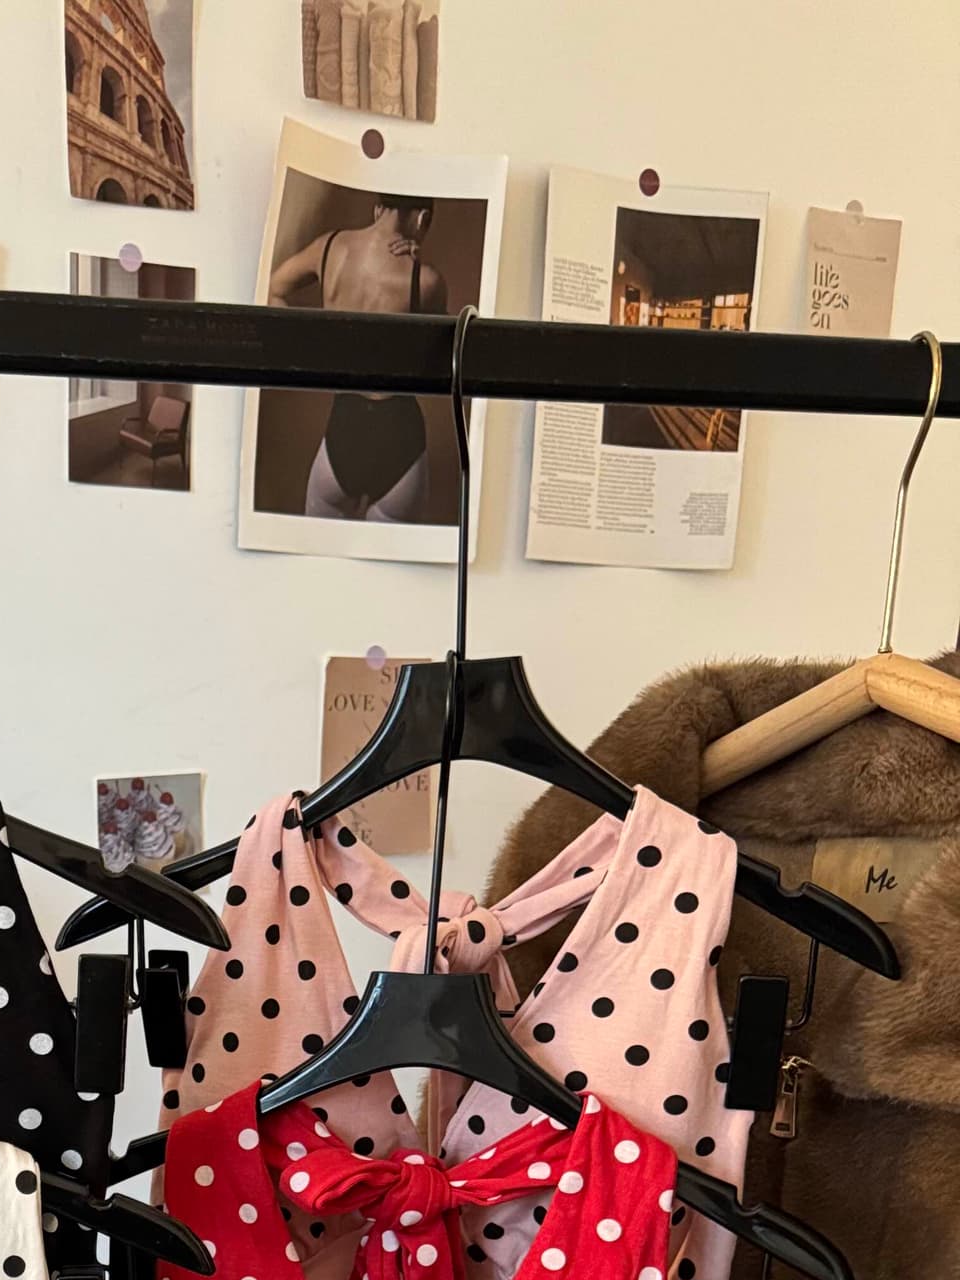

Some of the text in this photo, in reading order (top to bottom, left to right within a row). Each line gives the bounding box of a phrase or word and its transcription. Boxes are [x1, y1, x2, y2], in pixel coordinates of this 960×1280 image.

[813, 261, 839, 289] life
[811, 288, 849, 311] goes
[810, 311, 831, 330] on
[328, 693, 375, 713] OVE
[865, 865, 898, 894] Me
